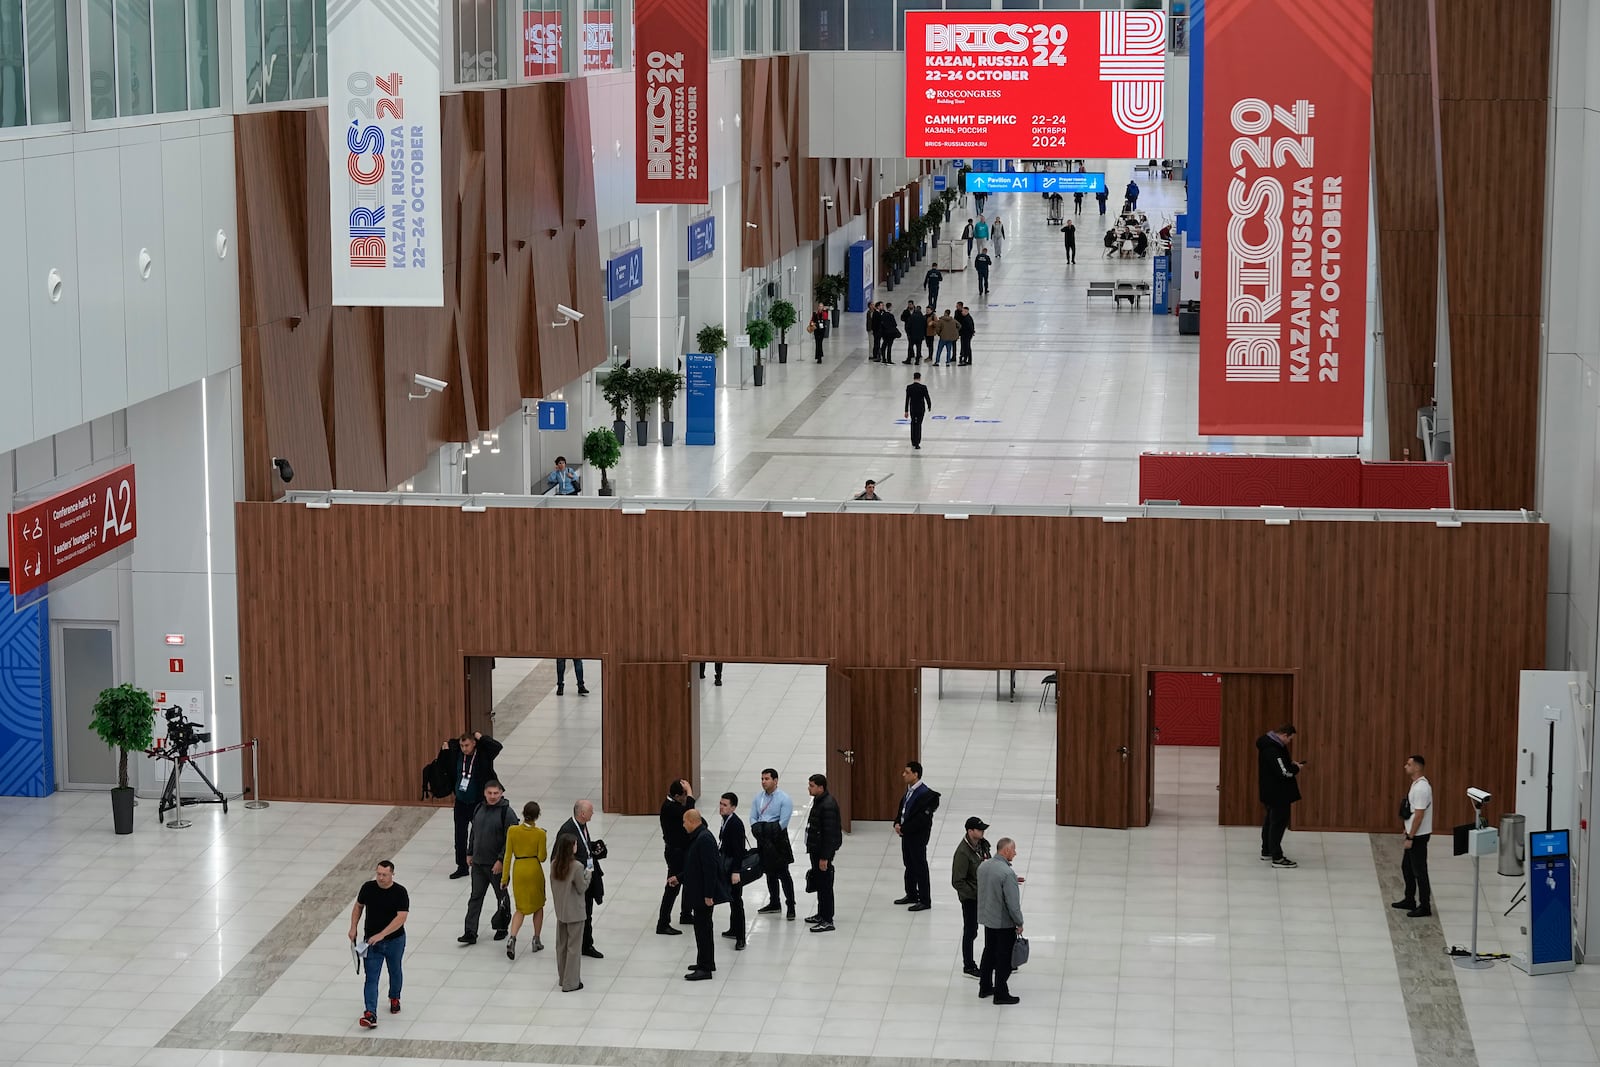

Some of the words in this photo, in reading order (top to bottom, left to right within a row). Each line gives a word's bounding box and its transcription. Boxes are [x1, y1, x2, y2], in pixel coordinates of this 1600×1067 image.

[926, 24, 1030, 52] BRICS
[1032, 24, 1068, 46] 20
[1032, 46, 1068, 66] 24
[647, 51, 666, 83] 20
[666, 52, 684, 84] 24
[926, 56, 976, 68] KAZAN,
[978, 56, 1028, 66] RUSSIA
[966, 70, 1028, 80] OCTOBER
[347, 72, 375, 119] 20
[376, 72, 404, 120] 24
[676, 86, 684, 132] RUSSIA
[688, 86, 697, 144] OCTOBER
[936, 90, 1002, 98] ROSCONGRESS
[647, 86, 672, 180] BRICS
[925, 115, 976, 125] САММИТ
[978, 115, 1017, 125] БРИКС
[1032, 136, 1066, 147] 2024
[1230, 98, 1272, 168] 20
[1273, 100, 1315, 168] 24
[391, 126, 404, 196] RUSSIA
[410, 126, 424, 212] OCTOBER
[676, 134, 686, 180] KAZAN,
[348, 126, 386, 268] BRICS
[1012, 177, 1028, 188] A1
[392, 200, 406, 268] KAZAN,
[704, 221, 713, 250] A2
[1292, 176, 1313, 278] RUSSIA
[1320, 176, 1342, 302] OCTOBER
[628, 254, 640, 288] A2
[1226, 176, 1284, 382] BRICS
[1290, 284, 1314, 382] KAZAN,
[52, 503, 78, 520] Conference
[78, 497, 88, 510] halls
[102, 479, 132, 543] A2
[72, 532, 90, 544] lounges
